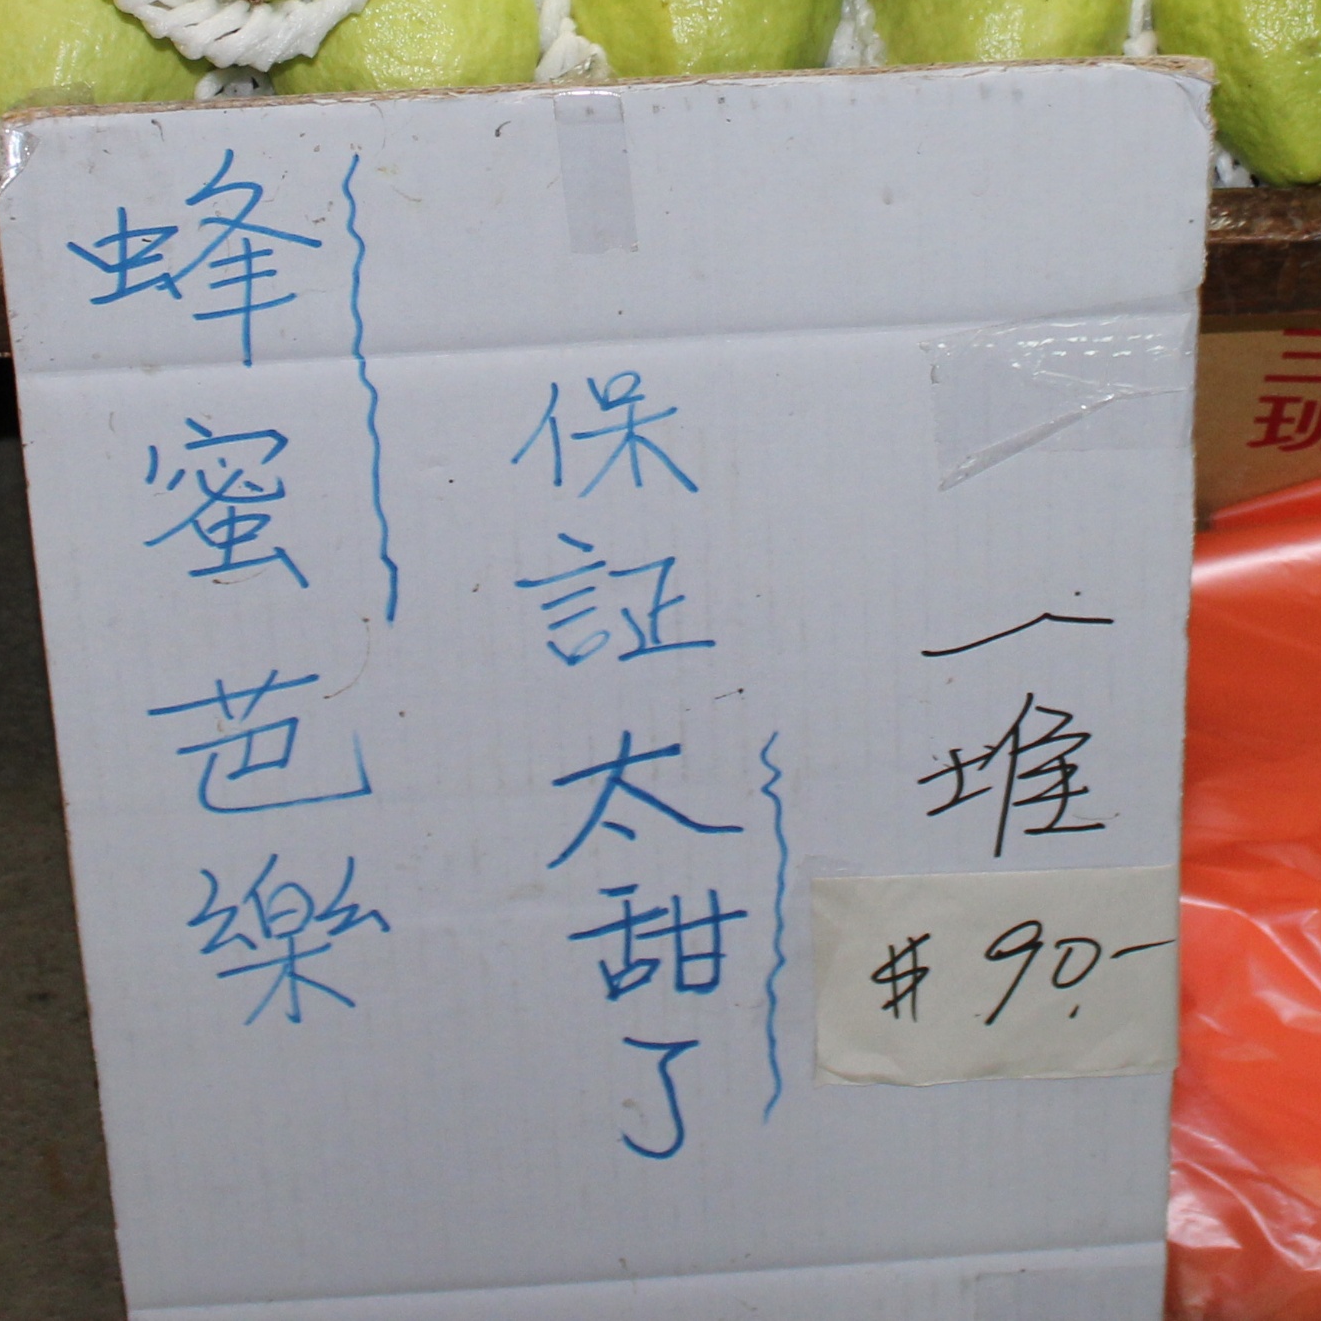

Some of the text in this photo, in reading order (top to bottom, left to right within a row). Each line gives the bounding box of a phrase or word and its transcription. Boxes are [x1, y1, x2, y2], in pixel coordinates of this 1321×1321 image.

[65, 148, 390, 1027] 蜂蜜芭樂
[918, 612, 1114, 858] 一堆
